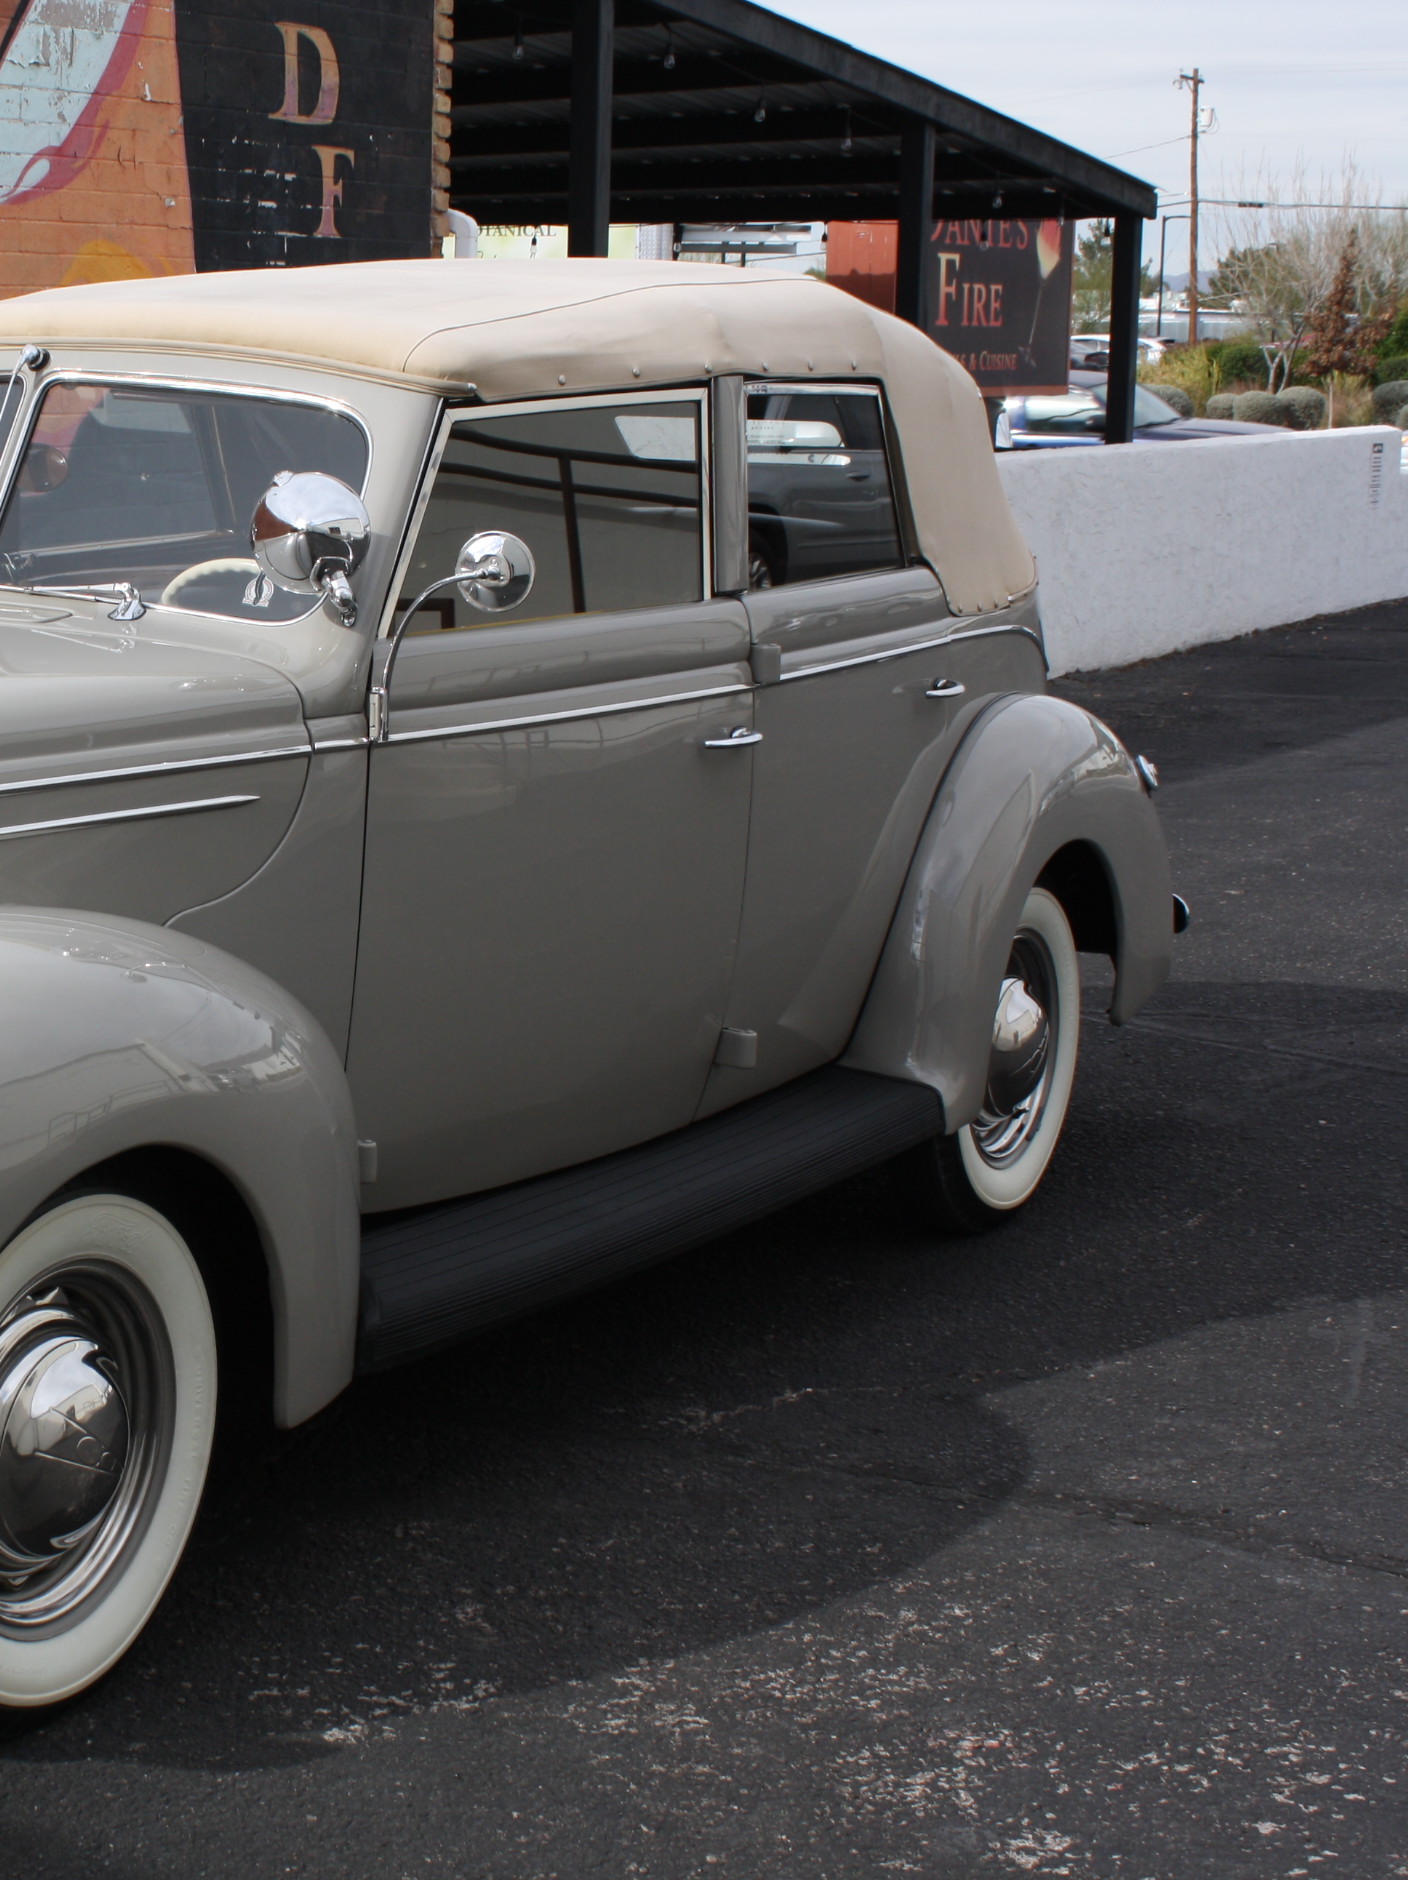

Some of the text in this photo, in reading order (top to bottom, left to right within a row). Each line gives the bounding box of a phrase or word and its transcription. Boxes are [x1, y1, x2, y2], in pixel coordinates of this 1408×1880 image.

[268, 21, 340, 125] D
[311, 145, 355, 238] F
[931, 218, 1030, 250] ANES
[935, 252, 1004, 328] FIRE
